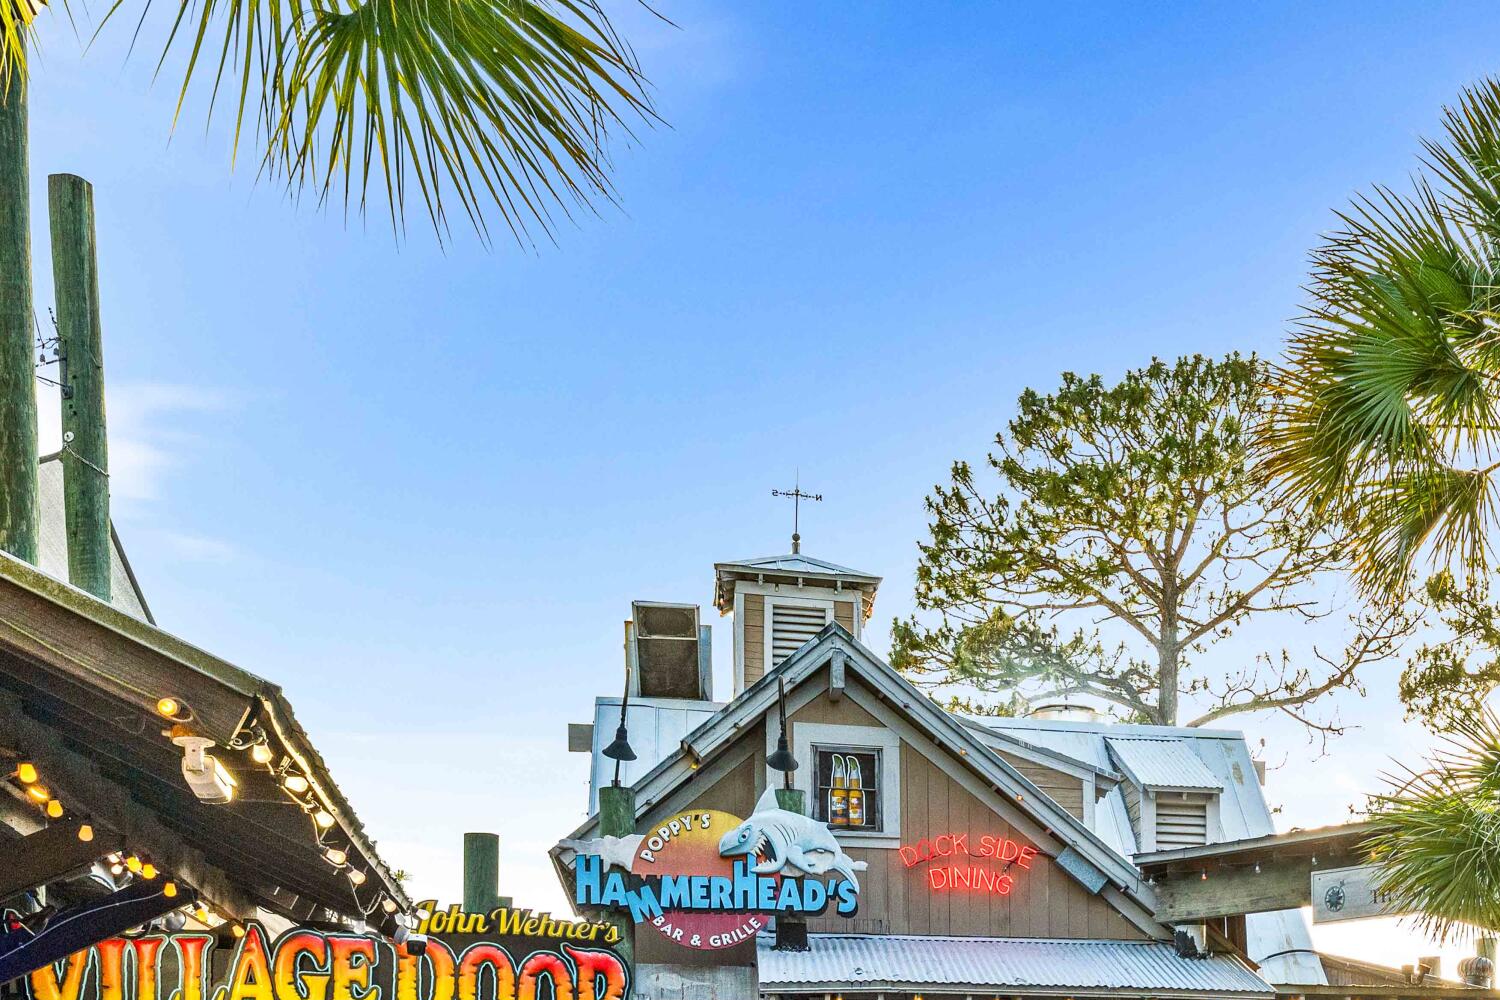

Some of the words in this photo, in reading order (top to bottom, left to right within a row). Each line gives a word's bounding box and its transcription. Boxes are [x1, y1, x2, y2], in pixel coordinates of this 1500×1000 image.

[640, 813, 711, 862] POPPY'S
[899, 834, 969, 867] DOCK
[979, 835, 1037, 869] SIDE
[575, 852, 858, 923] HAMMERHEAD'S
[929, 866, 1013, 895] DINING
[411, 899, 489, 936] John
[490, 906, 623, 943] Wehner's
[652, 916, 683, 942] BAR
[690, 935, 702, 946] &
[709, 916, 762, 947] GRILLE
